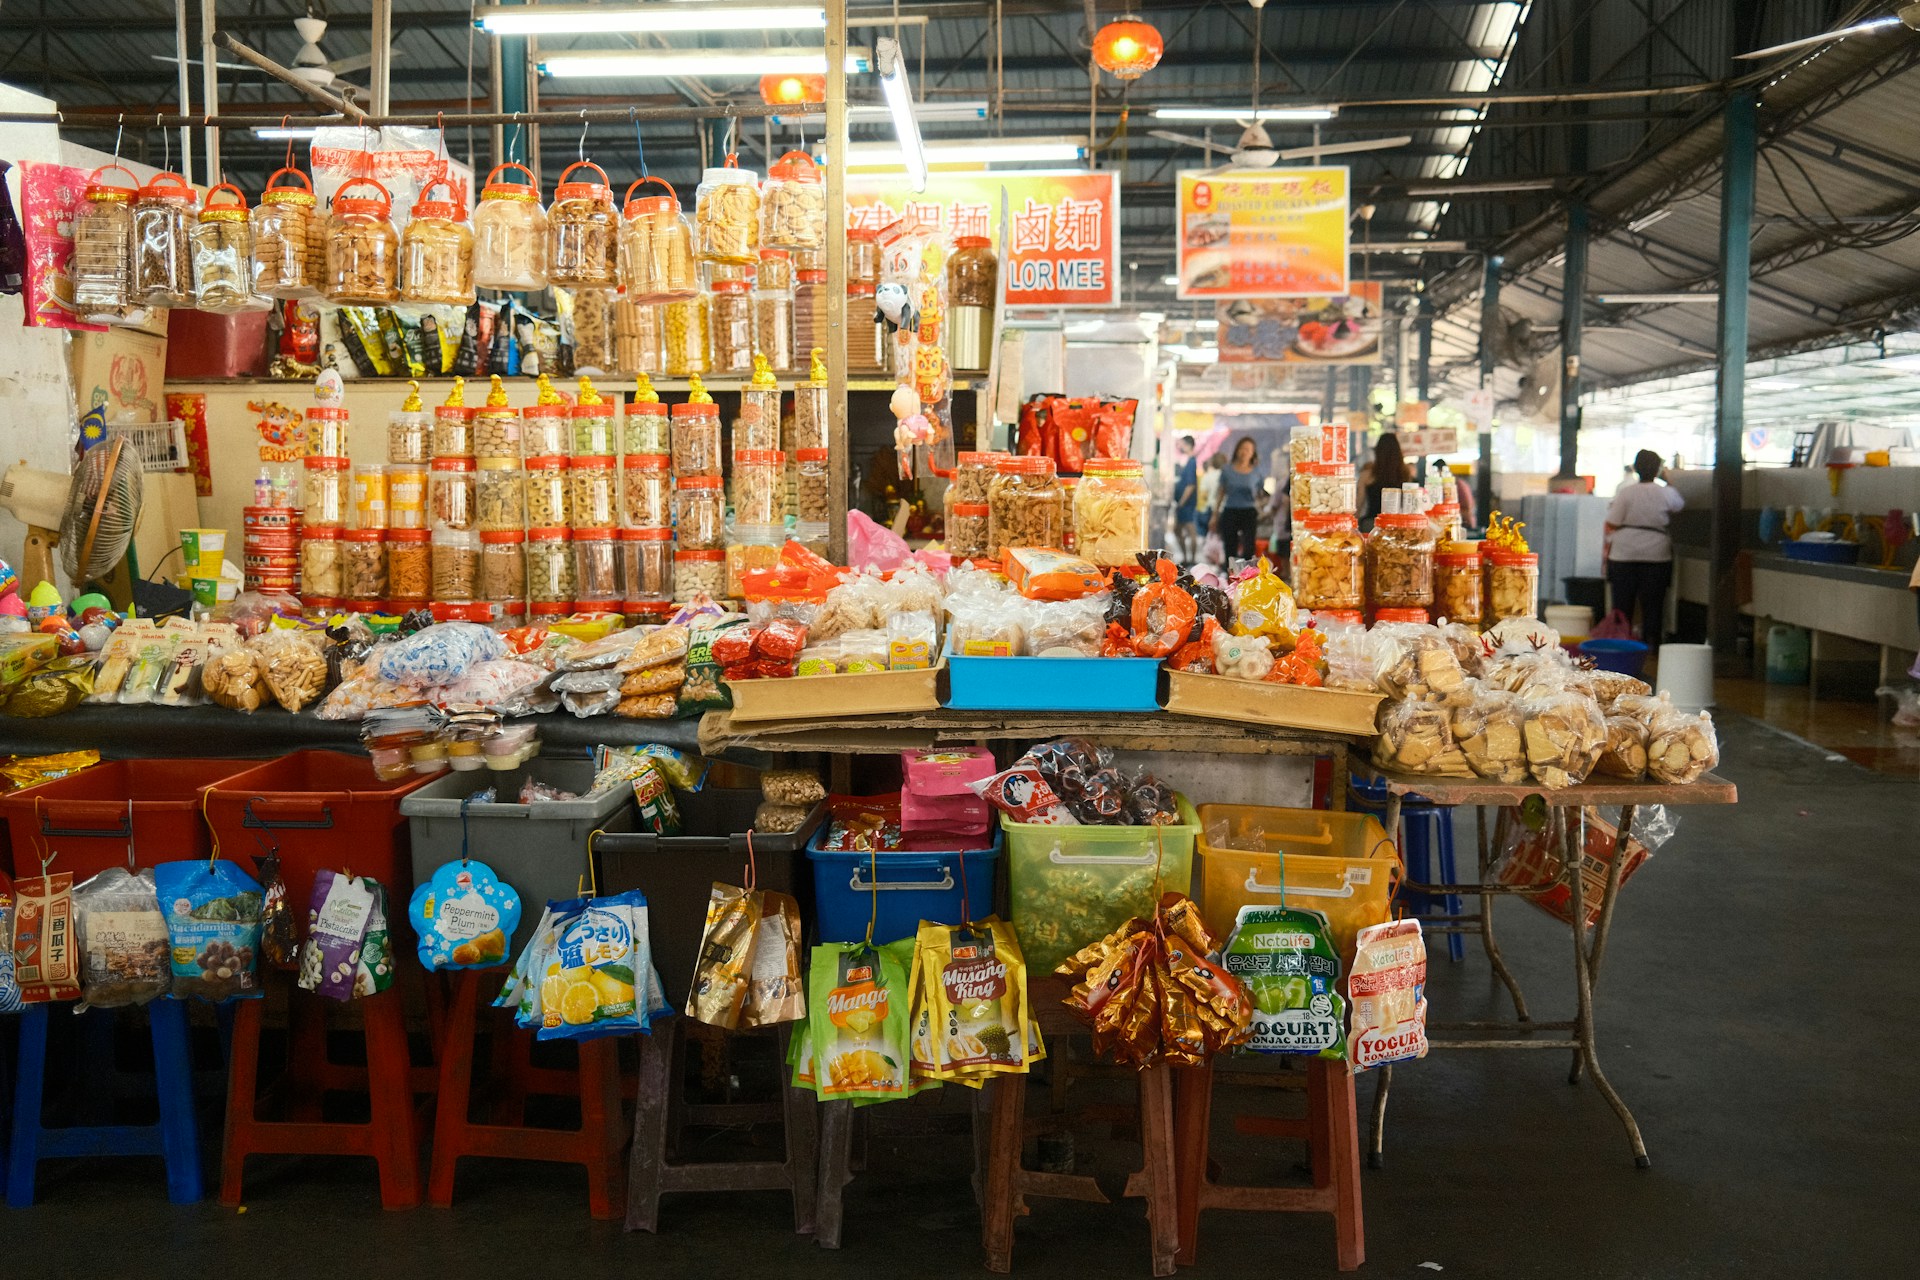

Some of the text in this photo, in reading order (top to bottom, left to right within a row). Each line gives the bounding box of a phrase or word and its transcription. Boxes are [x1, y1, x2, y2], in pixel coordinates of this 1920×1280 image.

[1011, 261, 1102, 288] LOR MEE
[443, 903, 496, 921] Peppermint
[451, 916, 475, 929] Plum
[51, 917, 65, 962] 香瓜子
[1255, 934, 1310, 947] Natalife
[1228, 955, 1272, 971] 유산균
[1309, 956, 1334, 976] 젤리
[1373, 949, 1411, 967] Natalife
[942, 963, 1008, 987] Musang
[955, 980, 996, 999] King
[827, 989, 891, 1014] Mango
[1295, 1036, 1330, 1045] JELLY
